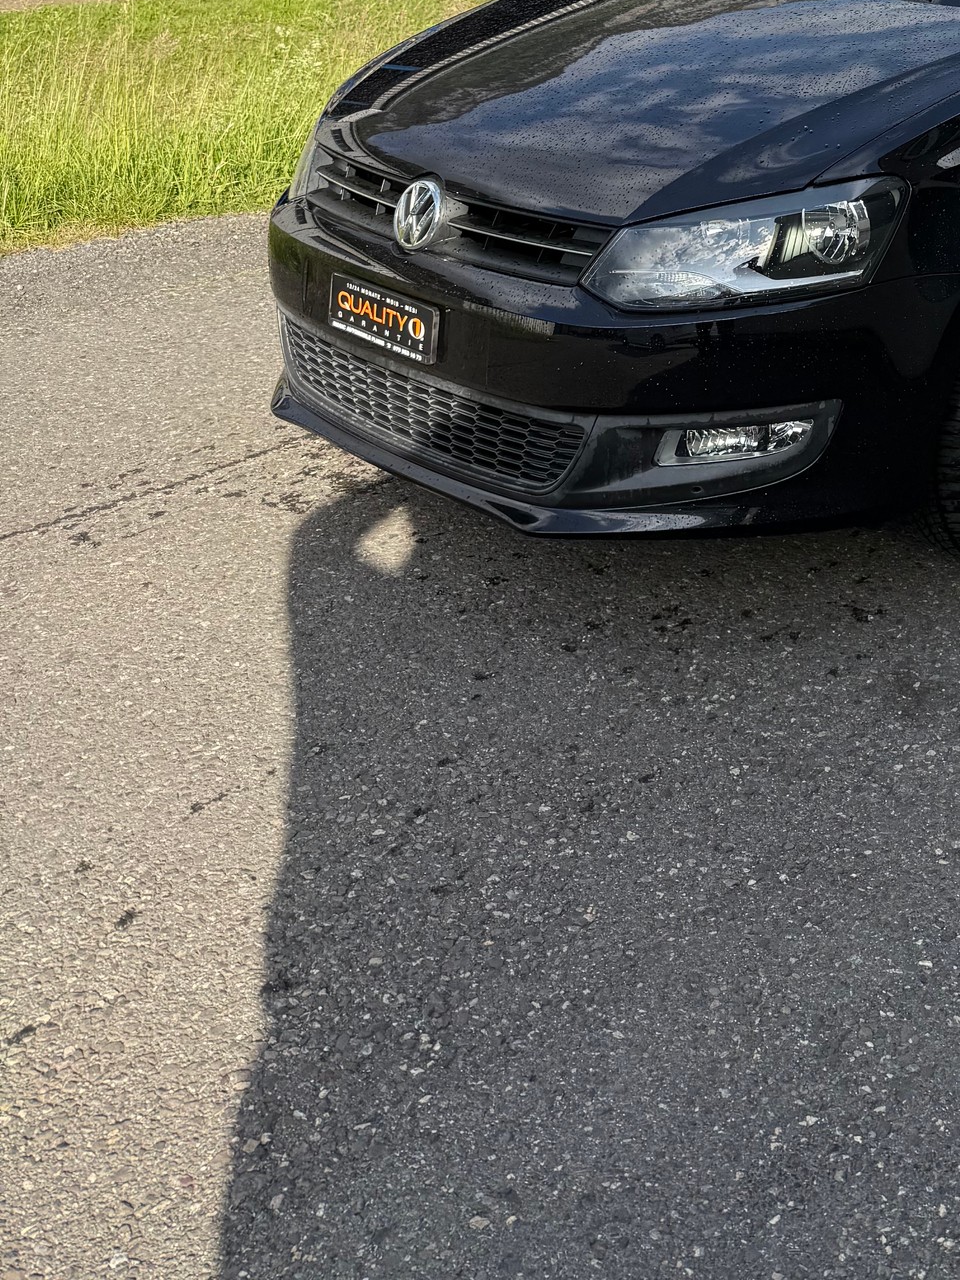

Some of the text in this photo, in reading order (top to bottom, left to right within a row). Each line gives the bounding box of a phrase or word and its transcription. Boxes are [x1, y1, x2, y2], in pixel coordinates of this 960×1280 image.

[337, 290, 408, 332] QUALITY
[361, 287, 381, 301] MONATE
[337, 310, 424, 351] GARANTIE
